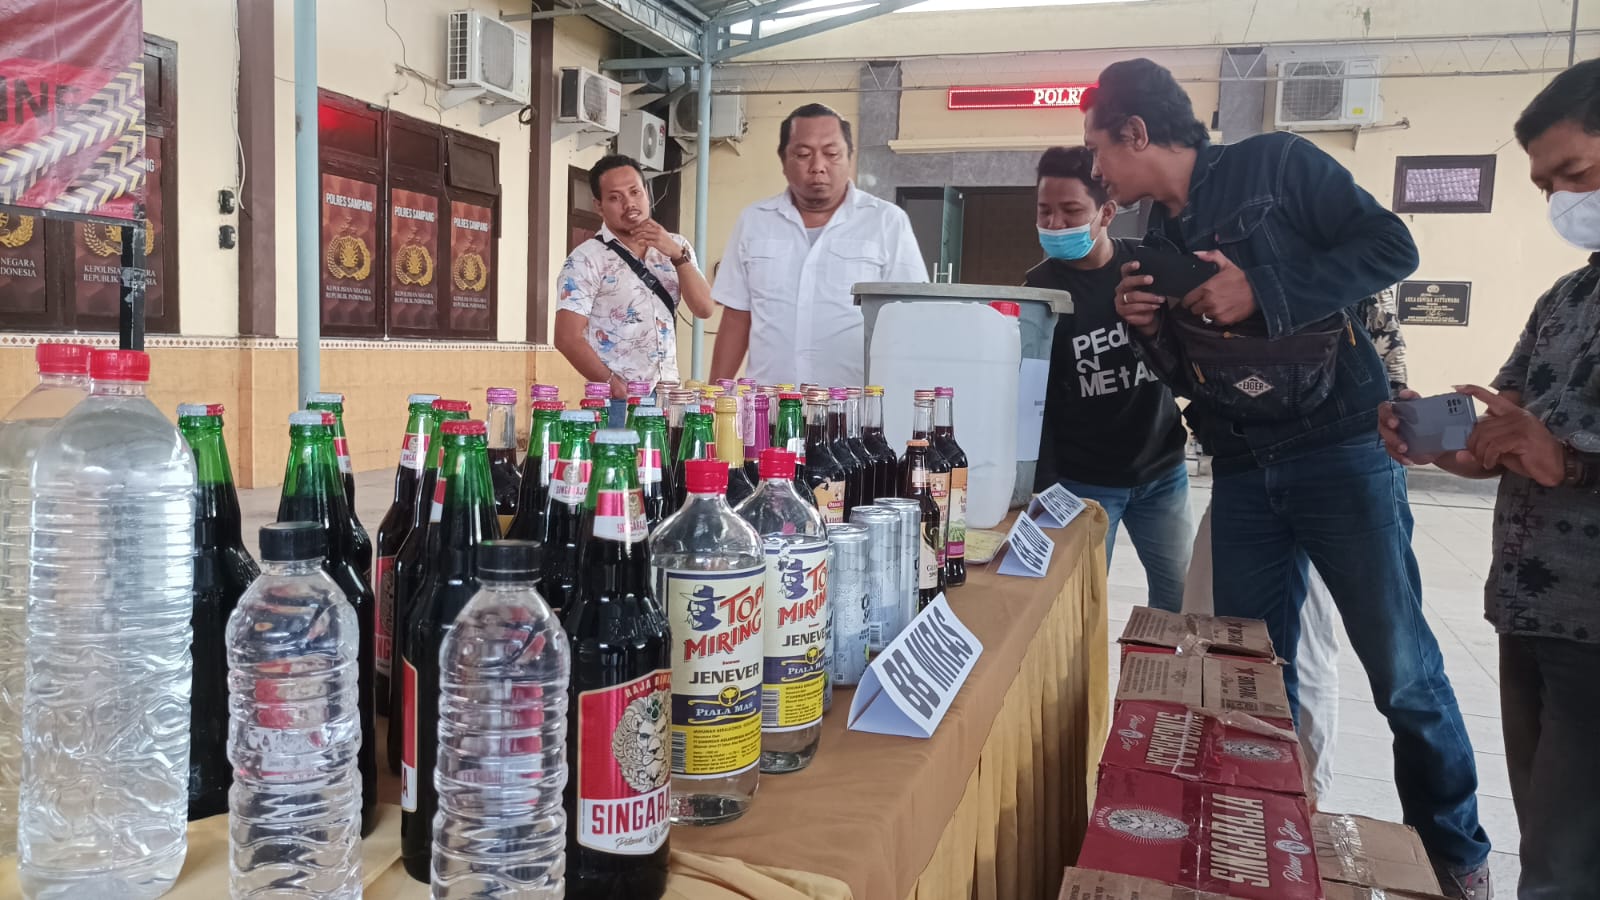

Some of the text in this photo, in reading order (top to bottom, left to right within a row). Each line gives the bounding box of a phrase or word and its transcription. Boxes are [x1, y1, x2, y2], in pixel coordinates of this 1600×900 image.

[1032, 87, 1084, 105] POLR
[326, 192, 373, 212] POLRES SAMPANG
[395, 206, 435, 222] POLRES SAMPANG
[0, 257, 35, 267] NEGARA
[84, 264, 121, 274] KEPOLISIA
[0, 267, 37, 277] DONESIA
[83, 273, 119, 283] REPUBLIK
[1079, 361, 1159, 397] MEtA
[1243, 381, 1264, 391] EIGER
[806, 559, 826, 595] TO
[778, 590, 826, 629] MIRIN
[684, 608, 761, 663] MIRING
[781, 627, 825, 647] JENEVE
[788, 663, 814, 675] PIALA
[882, 605, 973, 720] BB MIRAS
[689, 662, 759, 684] JENEVER
[625, 679, 651, 698] RAJA
[696, 701, 753, 717] PIALA MAS
[592, 786, 670, 835] SINGARA
[1210, 793, 1270, 888] SINGARAJA
